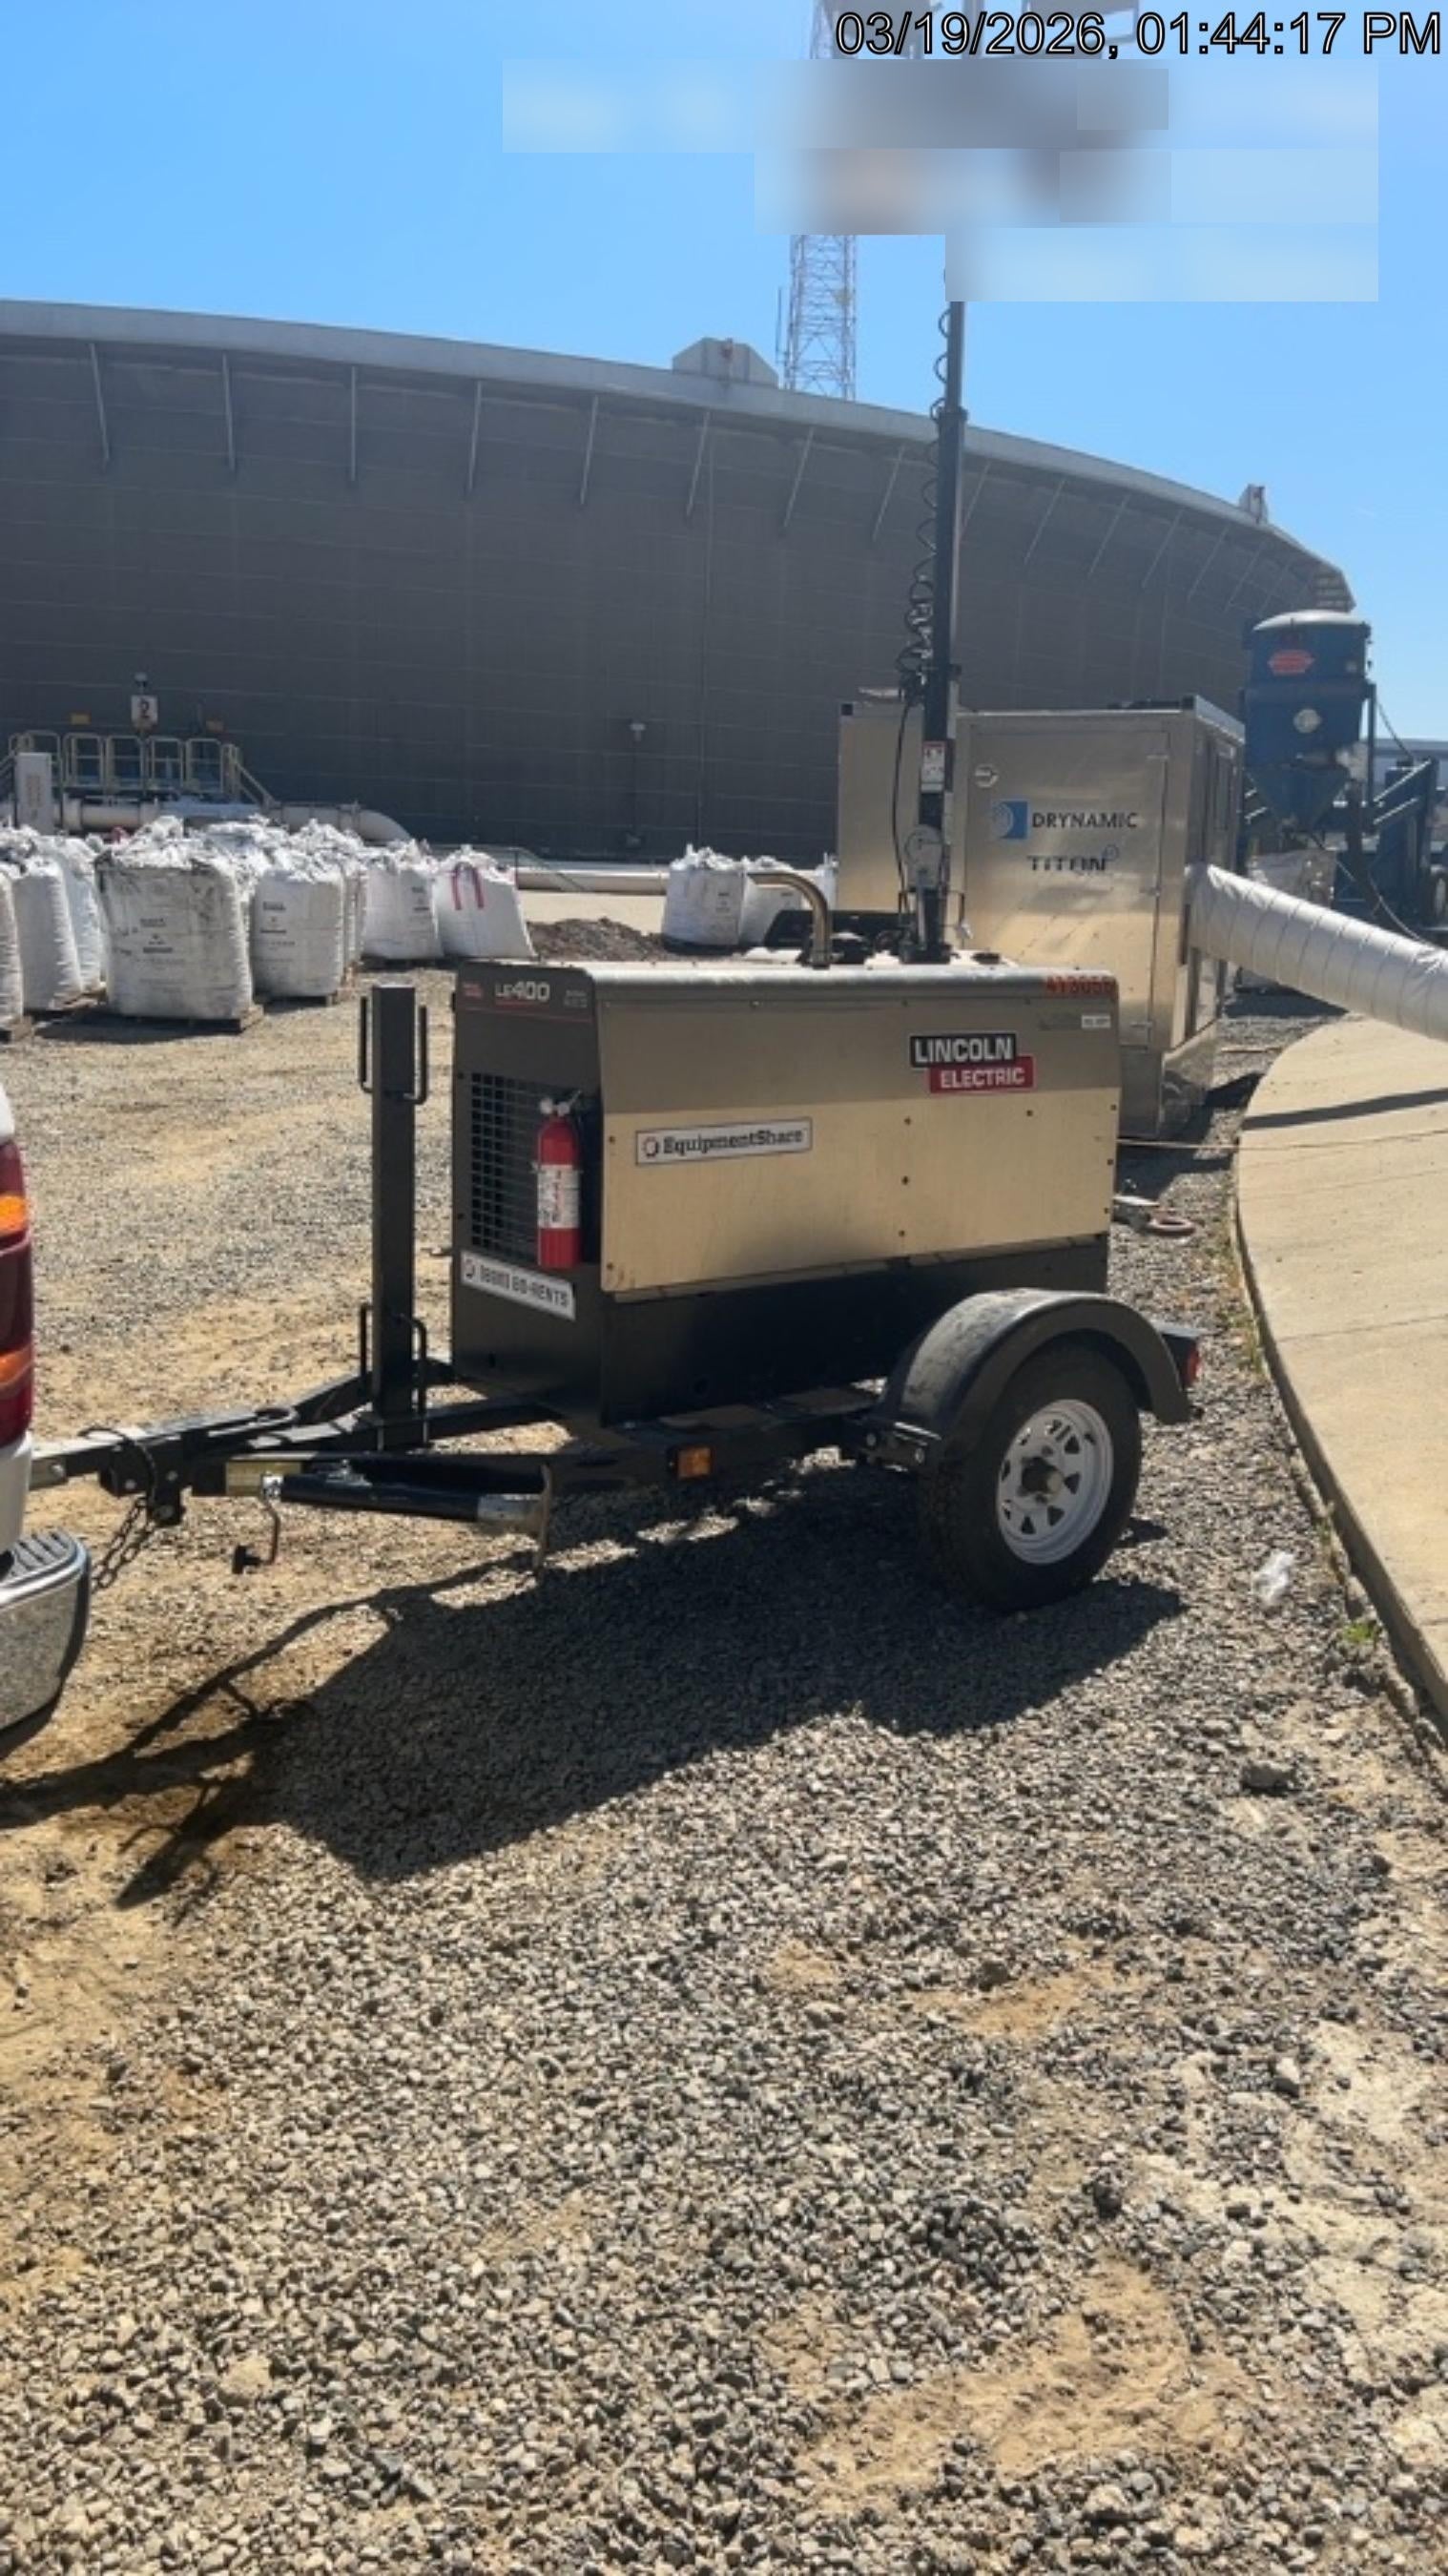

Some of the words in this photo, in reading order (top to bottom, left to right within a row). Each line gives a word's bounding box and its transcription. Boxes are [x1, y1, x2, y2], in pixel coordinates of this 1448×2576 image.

[1032, 812, 1138, 828] DRYNAMIC
[915, 1036, 1014, 1063] LINCOLN
[941, 1068, 1025, 1089] ELECTRIC
[663, 1129, 804, 1156] EquipmentShare
